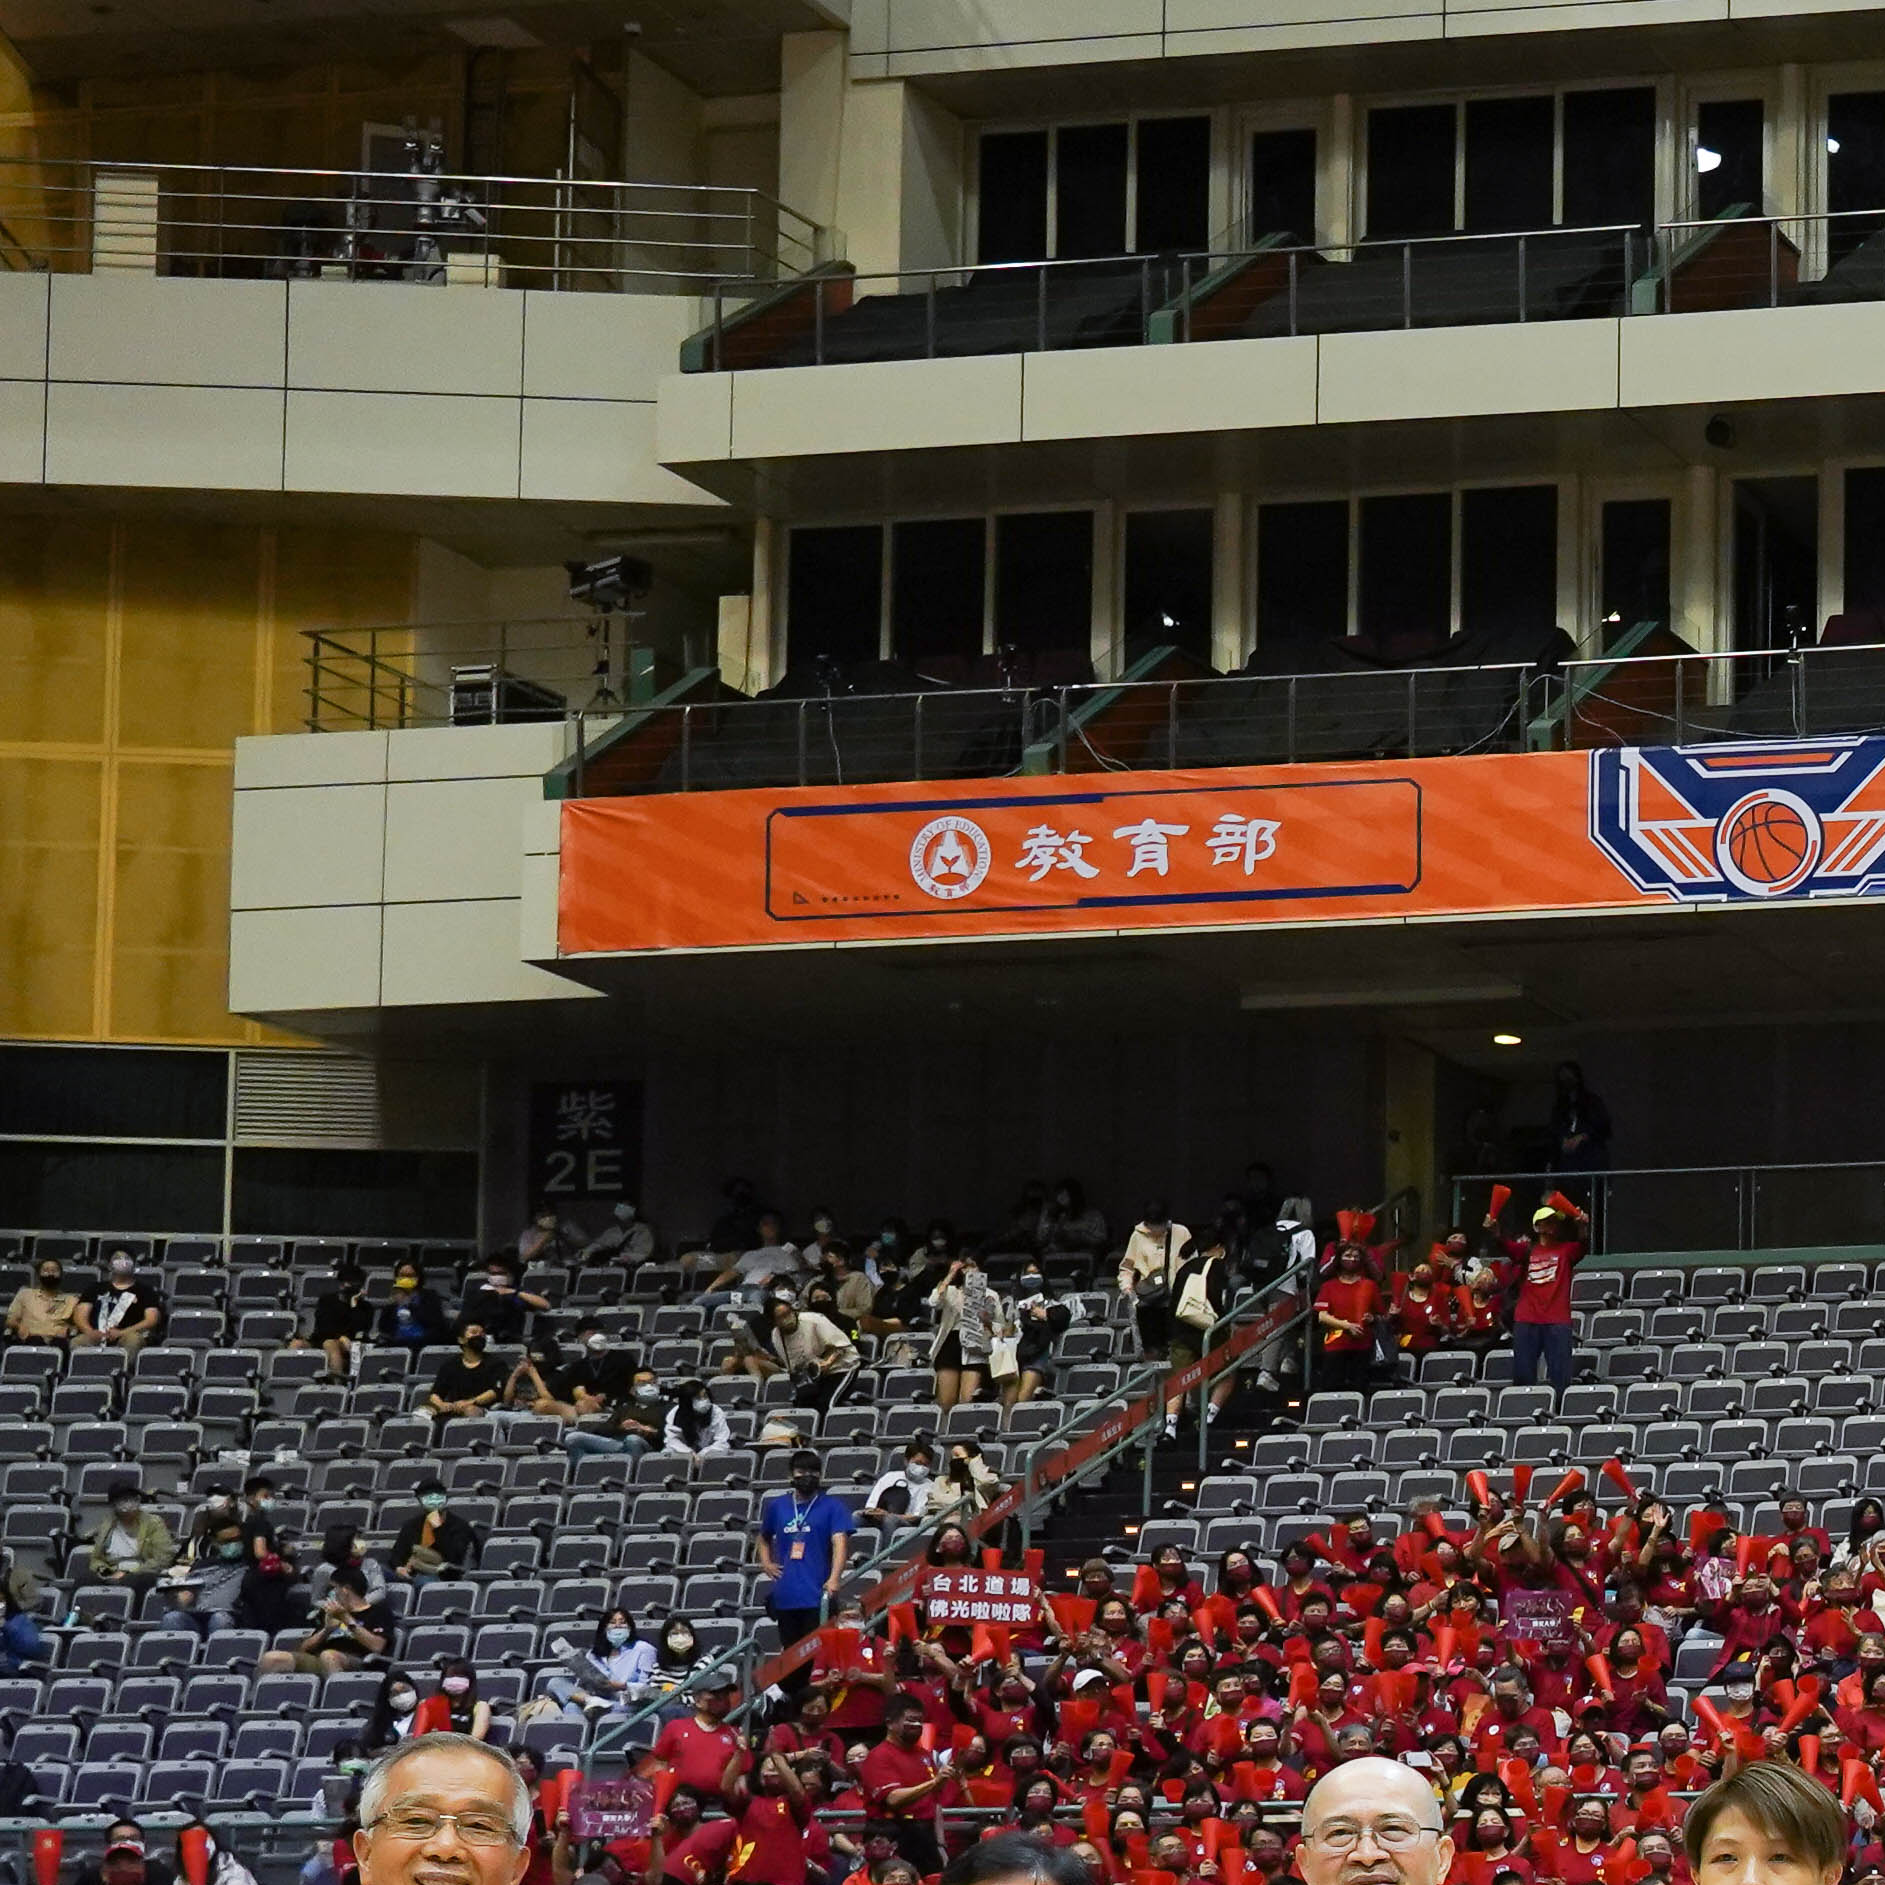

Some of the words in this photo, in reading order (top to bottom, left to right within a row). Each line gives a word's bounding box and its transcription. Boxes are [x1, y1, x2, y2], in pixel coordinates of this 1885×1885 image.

[1014, 813, 1282, 882] 教育部
[555, 1089, 616, 1142] 紫
[544, 1150, 624, 1192] 2E
[933, 1573, 1031, 1597] 台北道場
